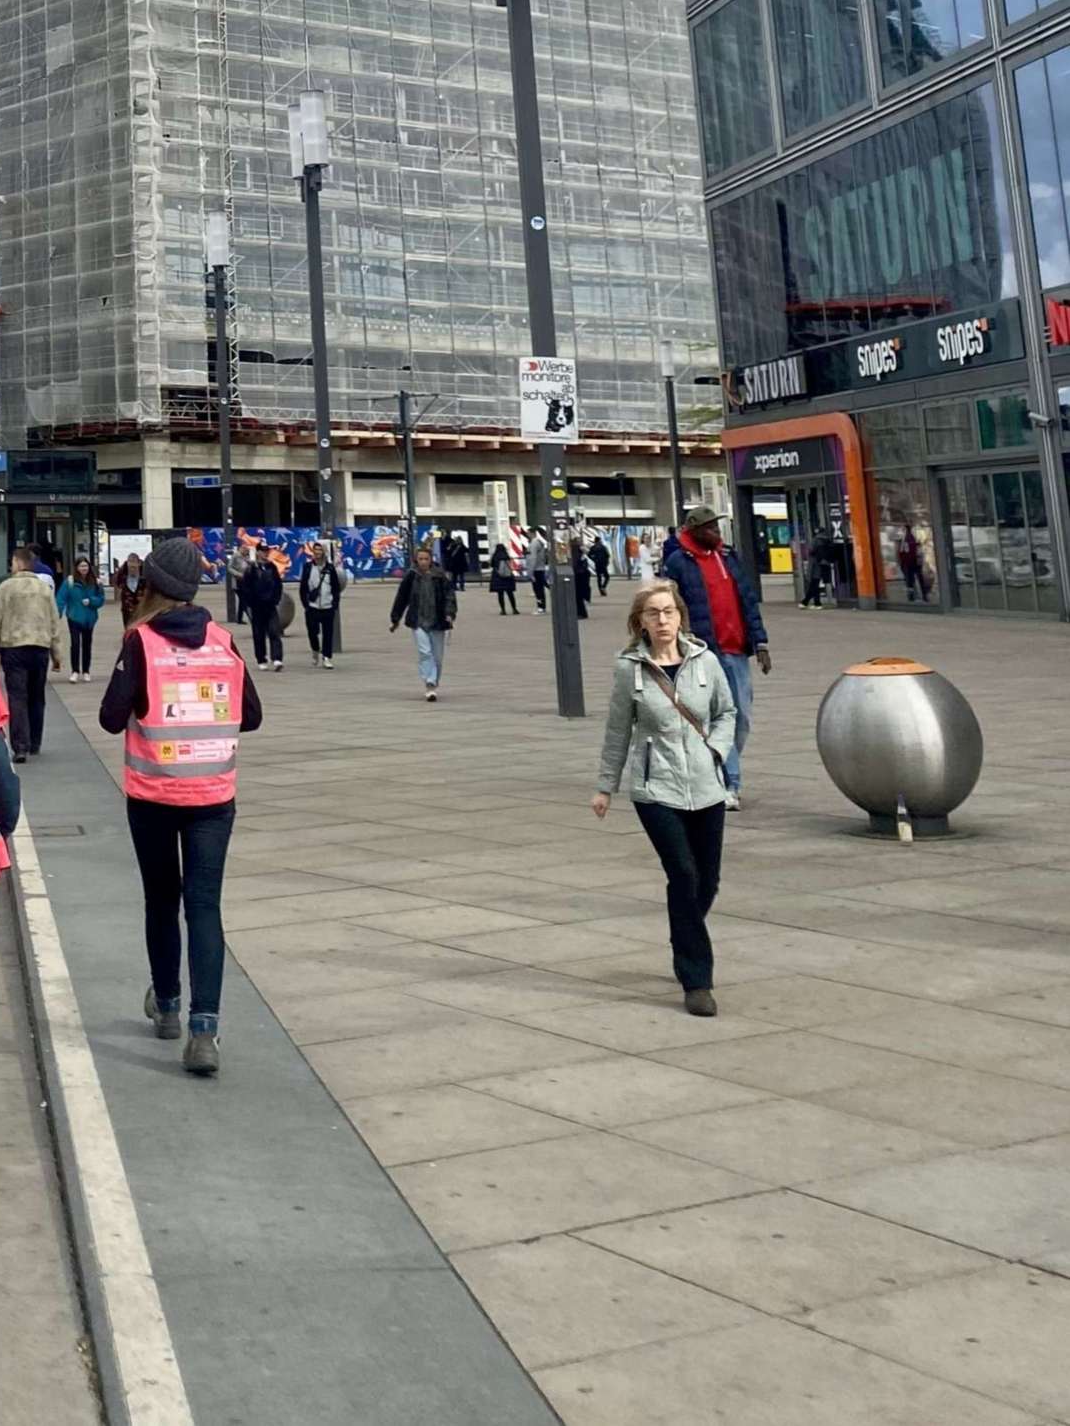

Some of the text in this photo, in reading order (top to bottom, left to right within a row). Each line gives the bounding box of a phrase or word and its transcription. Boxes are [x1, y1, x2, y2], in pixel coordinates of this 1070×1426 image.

[804, 147, 974, 304] SATURN
[857, 338, 897, 381] snipes
[937, 319, 984, 365] snipes
[538, 360, 573, 373] Werbe
[743, 356, 800, 405] SATURN
[754, 448, 799, 472] xperion
